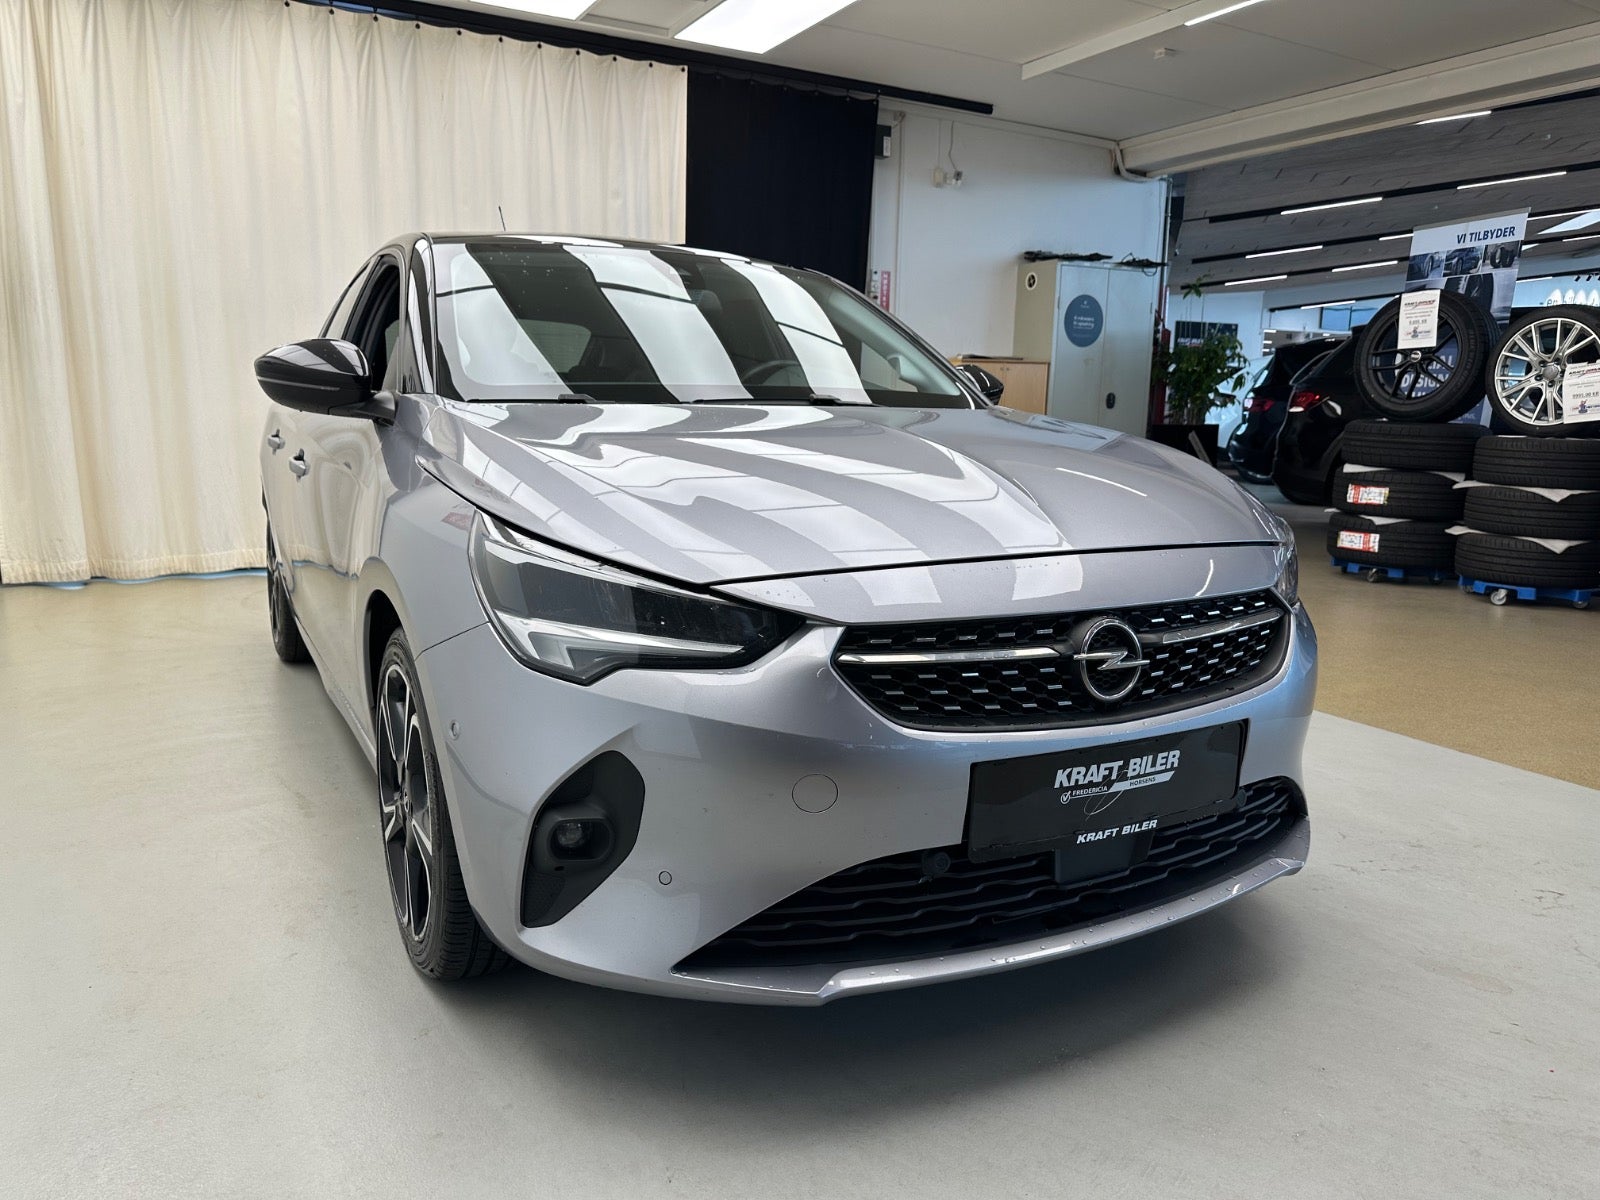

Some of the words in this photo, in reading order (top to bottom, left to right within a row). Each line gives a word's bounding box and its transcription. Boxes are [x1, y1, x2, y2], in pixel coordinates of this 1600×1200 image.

[1456, 233, 1466, 244] VI
[1469, 226, 1516, 243] TILBYDER
[1054, 760, 1124, 789] KRAFT
[1127, 750, 1180, 777] BILER
[1072, 785, 1108, 796] FREDERICIA
[1129, 776, 1156, 787] HORSENS
[1076, 827, 1119, 844] KRAFT
[1121, 819, 1158, 835] BILER
